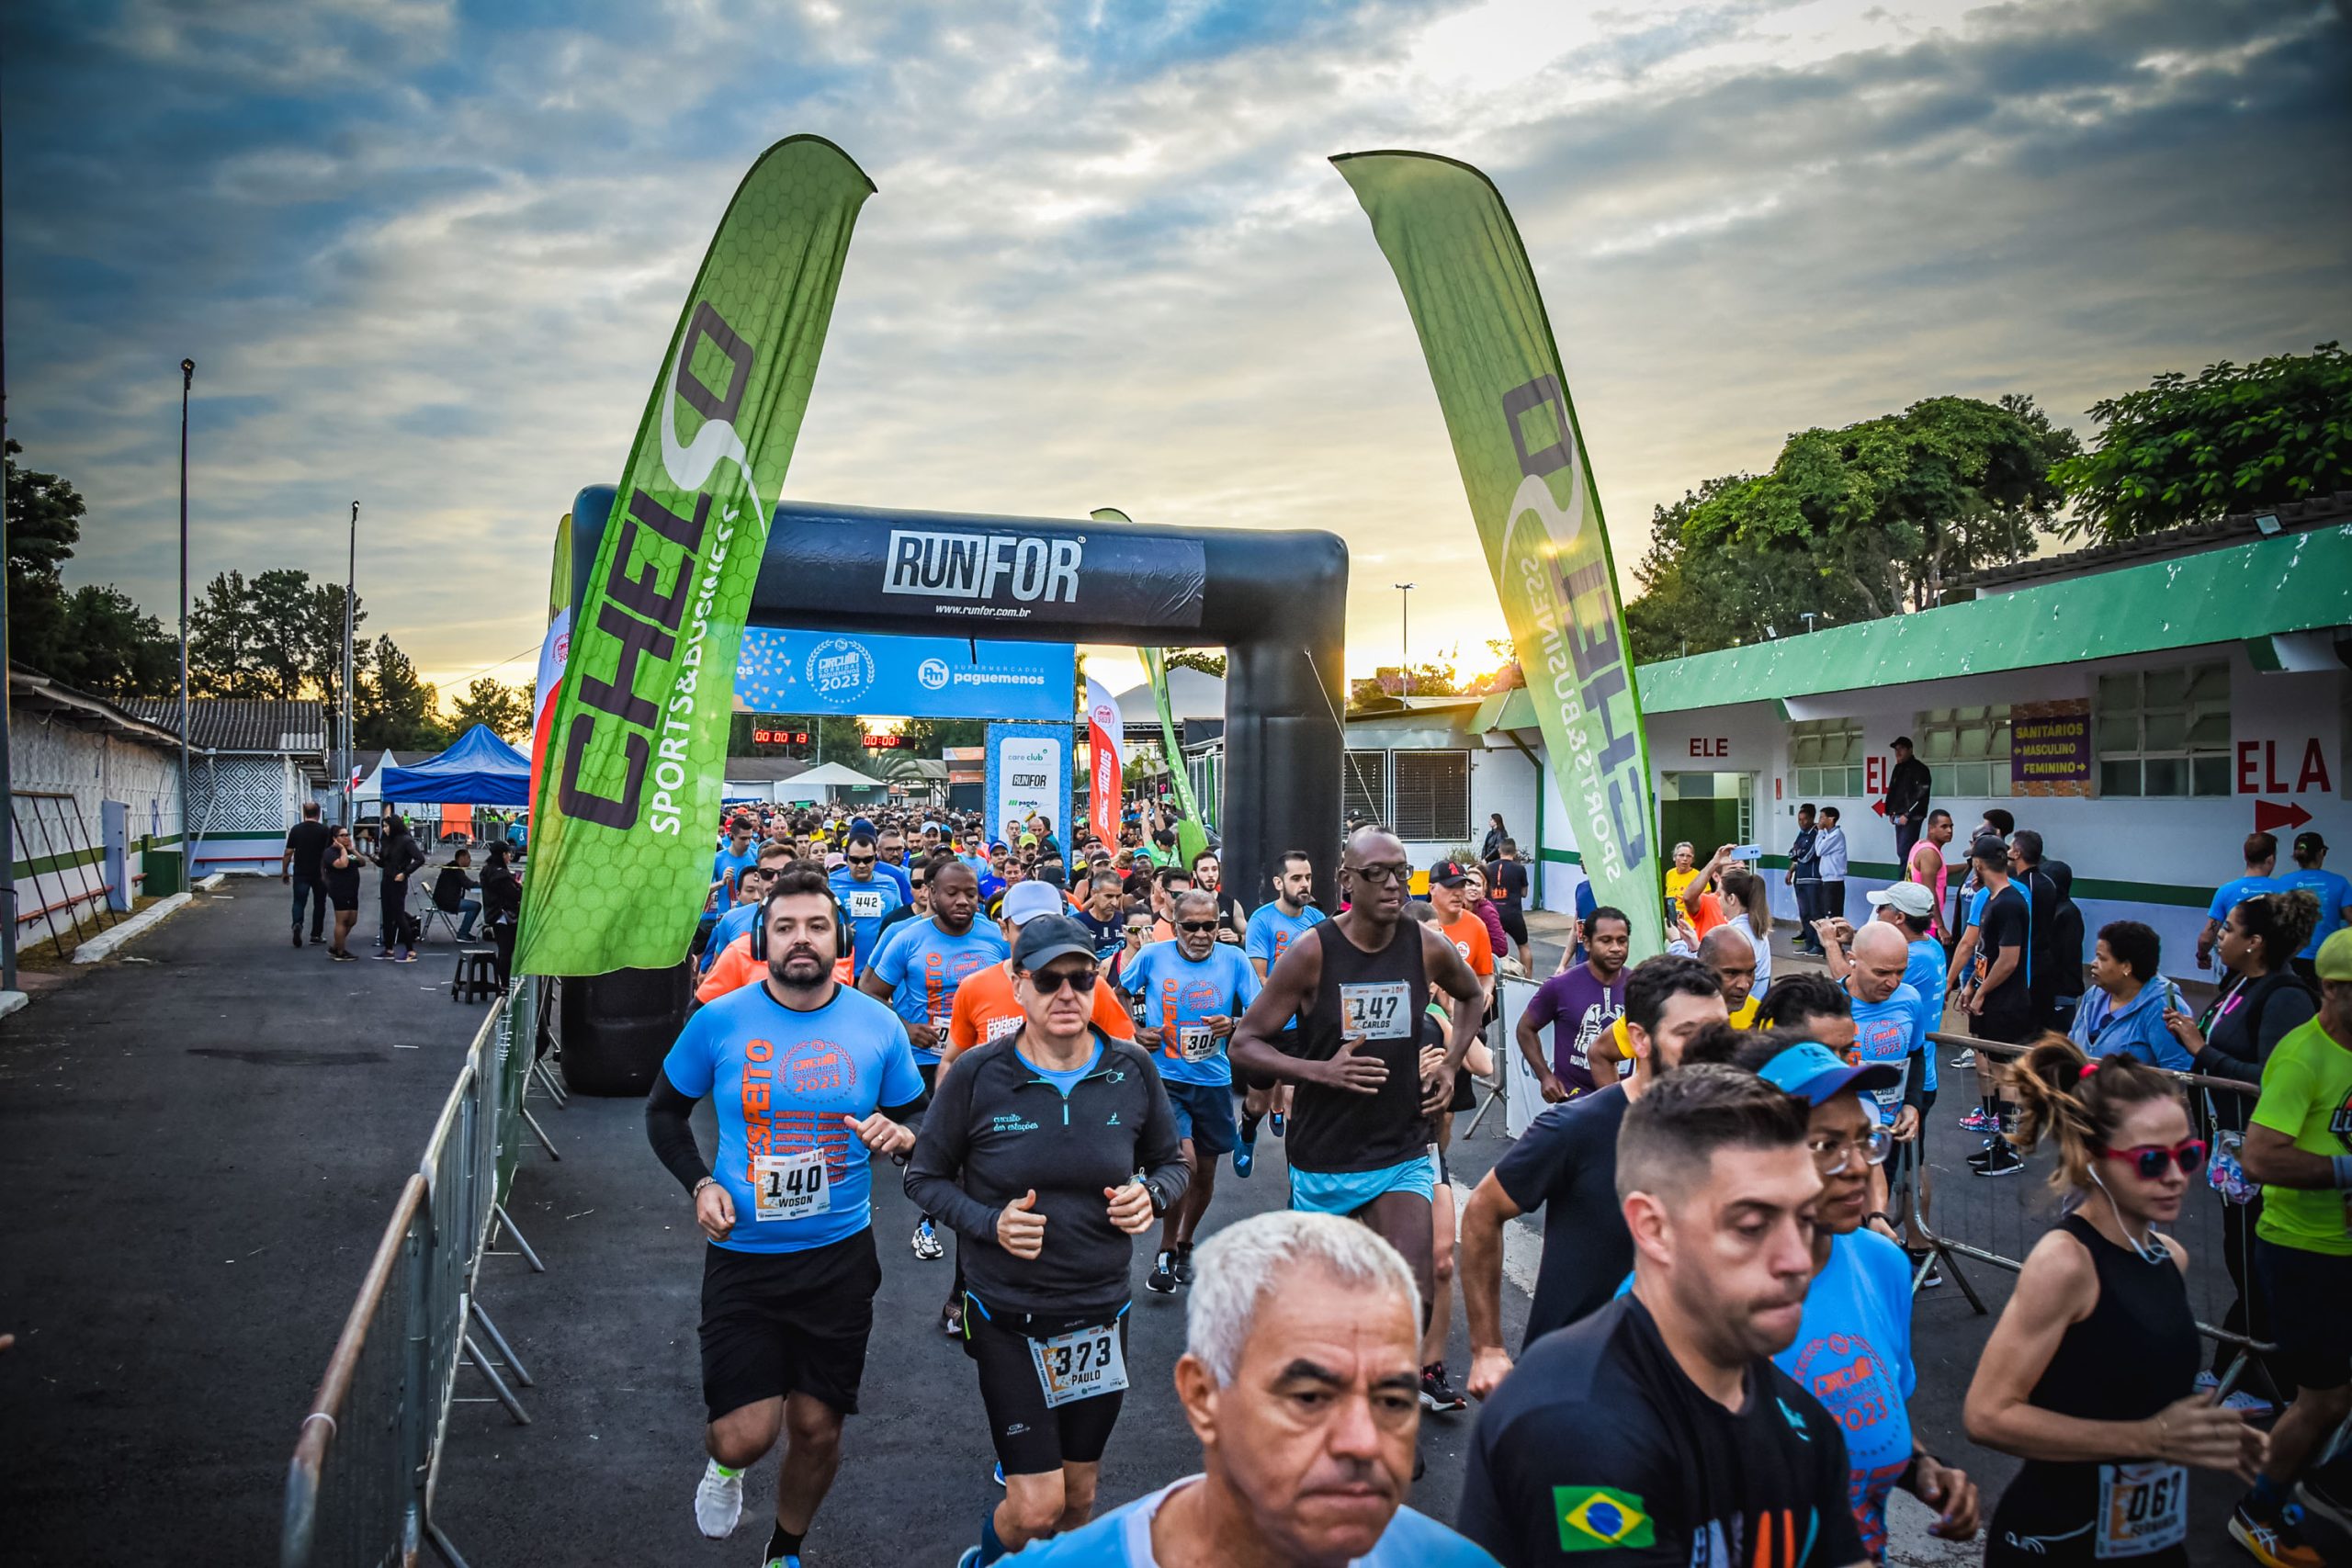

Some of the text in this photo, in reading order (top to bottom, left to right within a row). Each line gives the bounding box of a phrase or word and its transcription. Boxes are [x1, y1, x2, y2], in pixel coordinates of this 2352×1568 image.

[935, 604, 1031, 617] www.runfor.com.br
[650, 503, 740, 835] SPORTS&BUSINESS
[954, 664, 1045, 672] SUPERMERCADOS
[820, 673, 860, 692] 2023
[954, 672, 1045, 685] paguemenos
[2016, 720, 2084, 739] SANITÁRIOS
[1690, 738, 1728, 758] ELE
[2023, 742, 2075, 756] MASCULINO
[1026, 753, 1043, 761] club
[2023, 761, 2075, 774] FEMININO
[2237, 738, 2332, 795] ELA
[1867, 757, 1889, 794] EL
[855, 897, 877, 908] 442
[1353, 997, 1397, 1021] 147
[1362, 1021, 1390, 1029] CARLOS
[1874, 1043, 1901, 1056] 2023
[794, 1075, 841, 1093] 2023
[993, 1113, 1022, 1122] circuito
[1008, 1122, 1038, 1132] estações
[767, 1165, 821, 1198] 140
[1056, 1337, 1111, 1376] 373
[1071, 1370, 1101, 1385] PAULO
